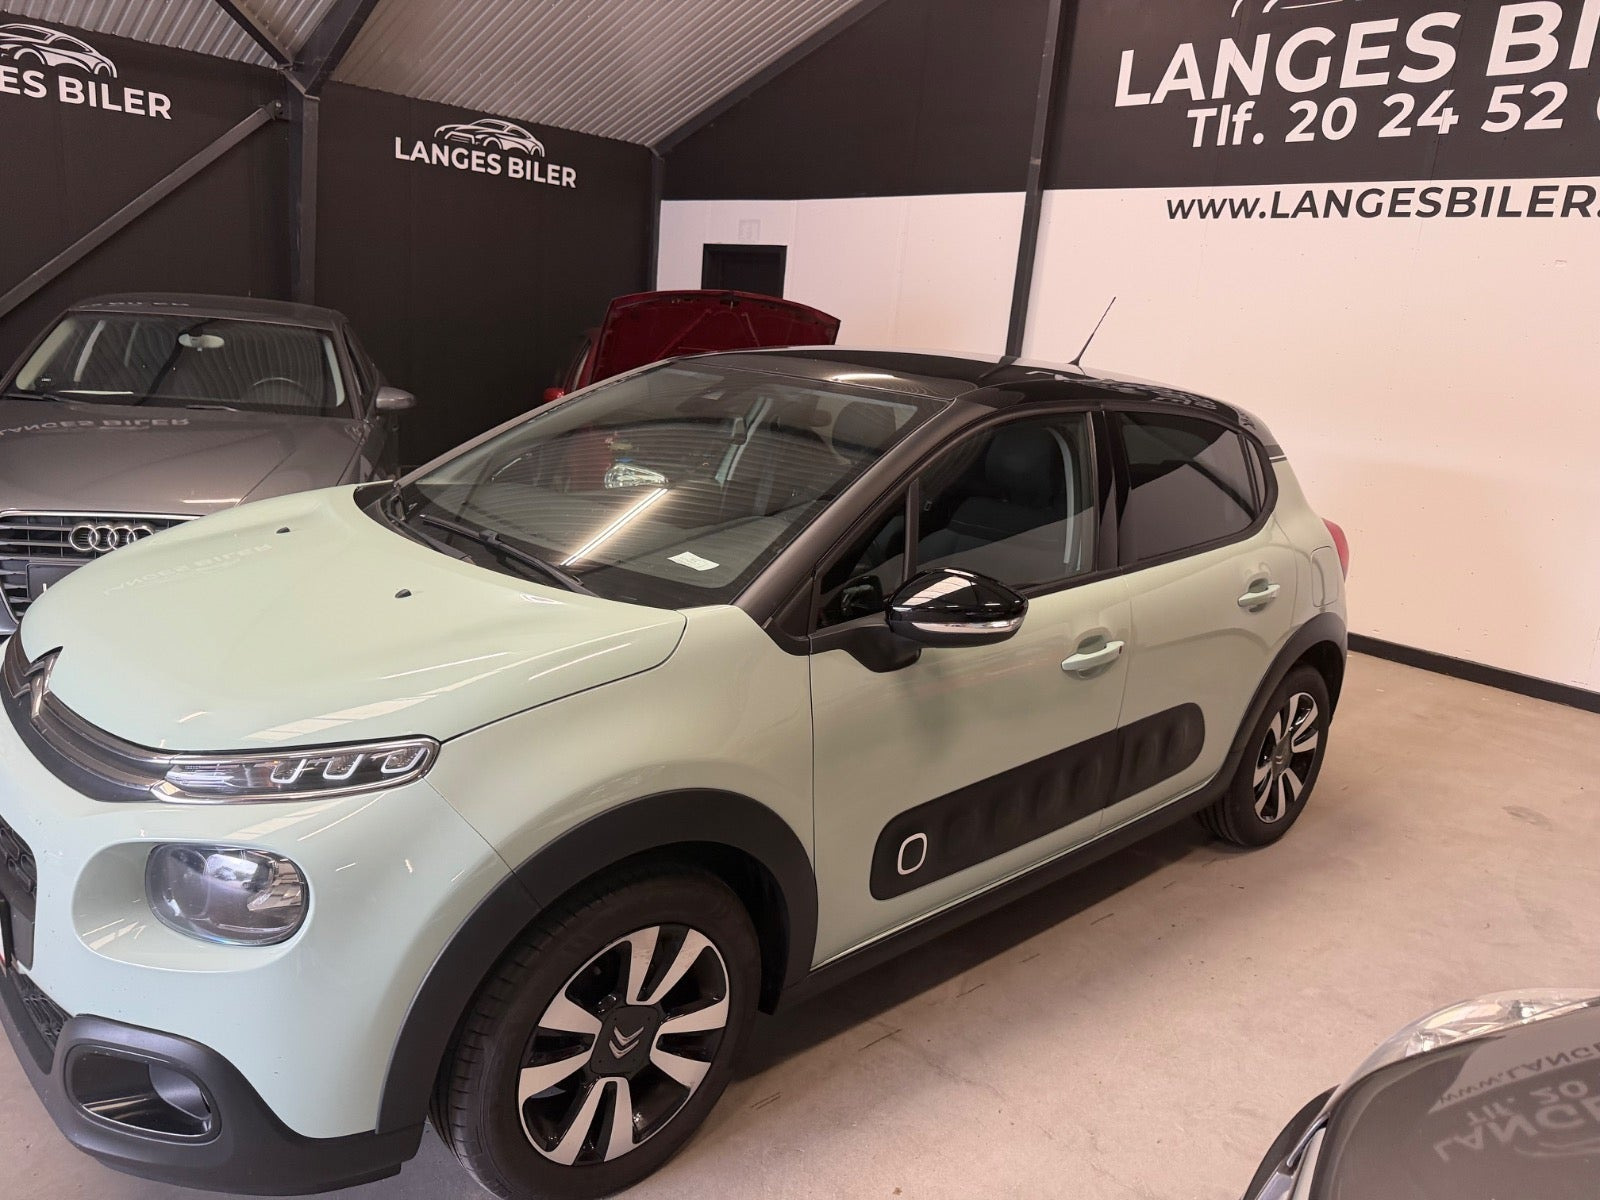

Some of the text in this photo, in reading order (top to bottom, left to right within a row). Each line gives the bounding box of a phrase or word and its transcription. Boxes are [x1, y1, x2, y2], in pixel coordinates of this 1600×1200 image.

[1115, 11, 1461, 107] LANGES
[58, 75, 172, 120] BILER
[1187, 101, 1264, 147] Tlf.
[1285, 97, 1357, 142] 20
[1378, 90, 1459, 138] 24
[1480, 81, 1568, 133] 52
[395, 136, 577, 188] LANGES BILER
